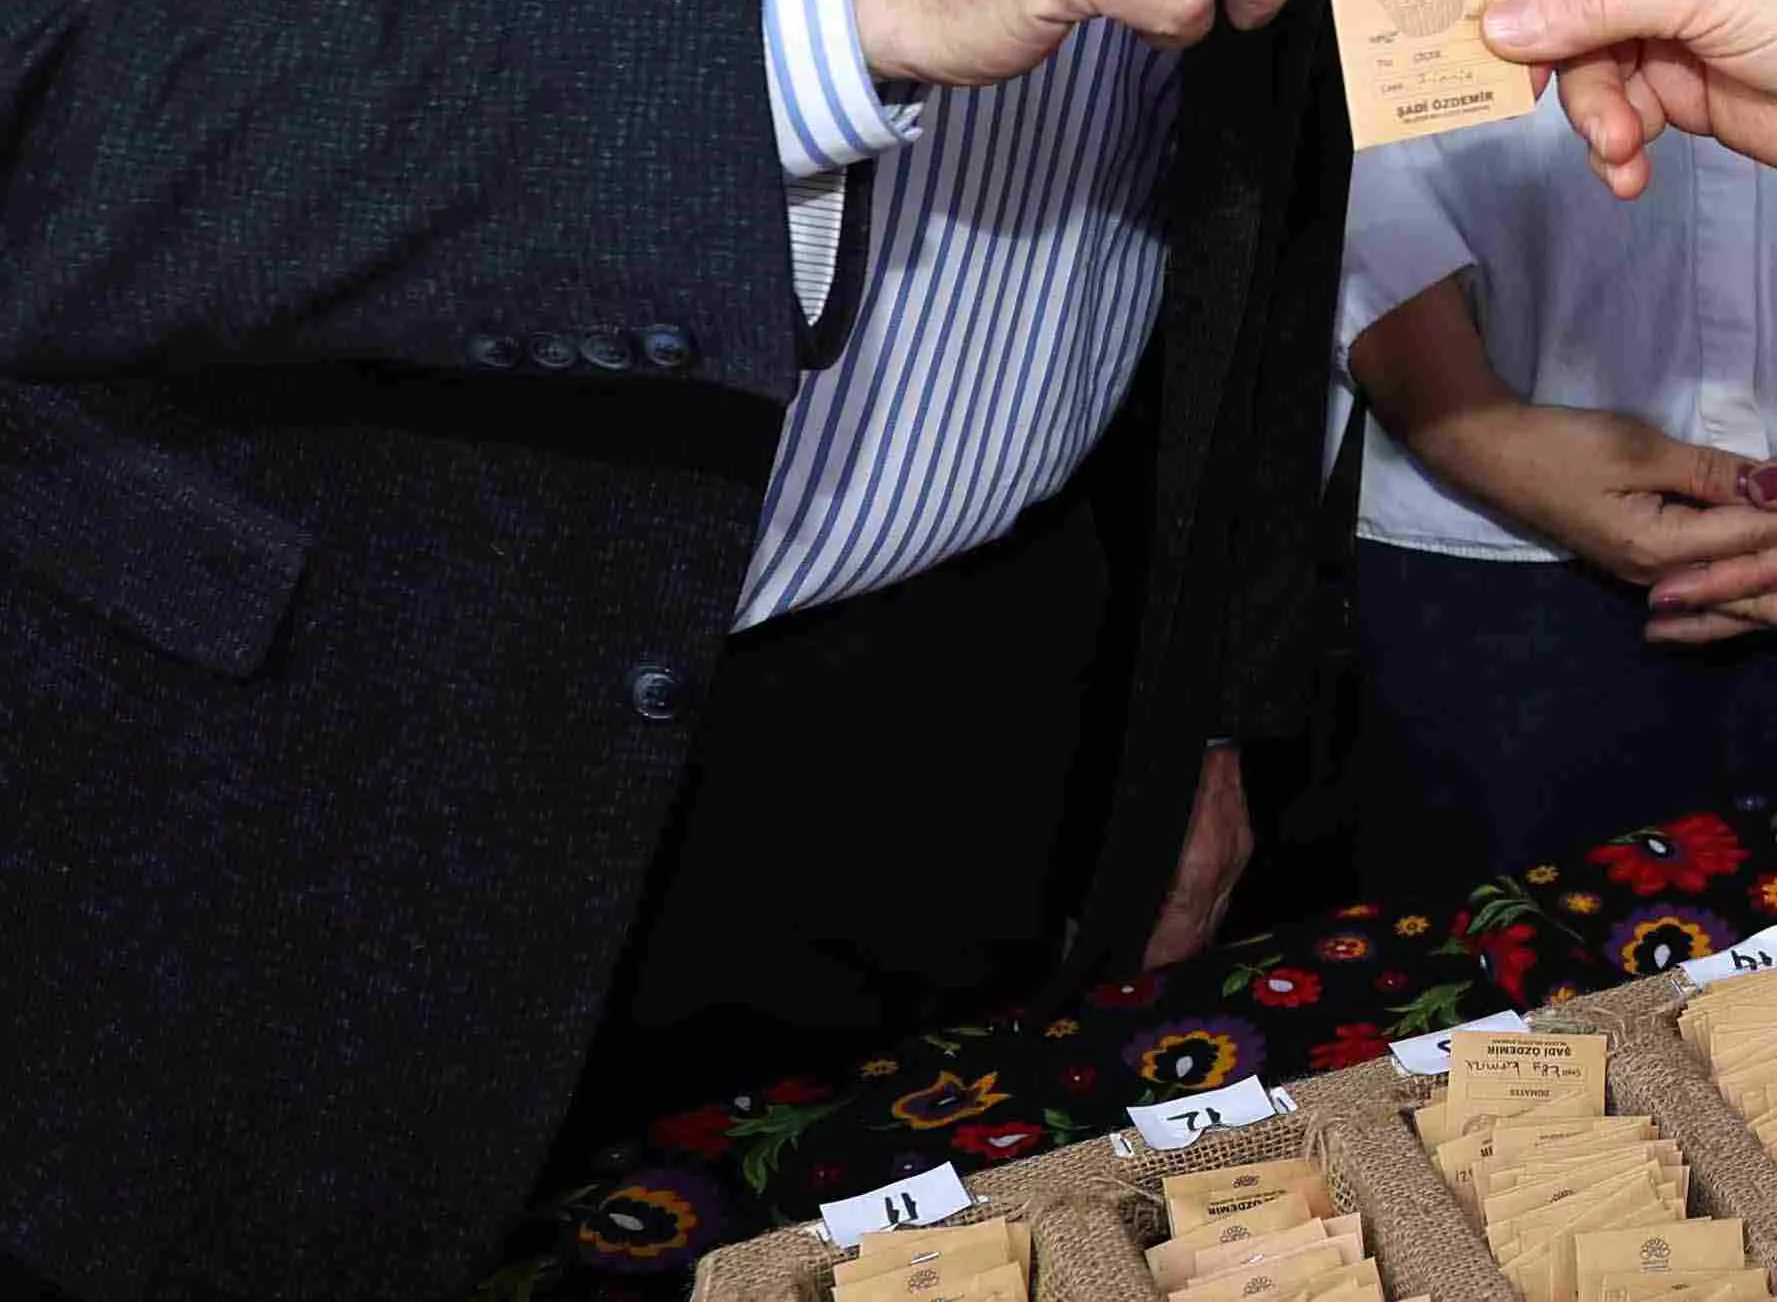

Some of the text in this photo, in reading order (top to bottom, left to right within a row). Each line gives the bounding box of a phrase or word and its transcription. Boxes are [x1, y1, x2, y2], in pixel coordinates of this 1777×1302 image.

[1397, 103, 1428, 118] ŞADİ
[1432, 90, 1494, 111] ÖZDEMİR
[1487, 1045, 1571, 1057] ŞADİ ÖZDEMİR
[1167, 1108, 1222, 1133] 12
